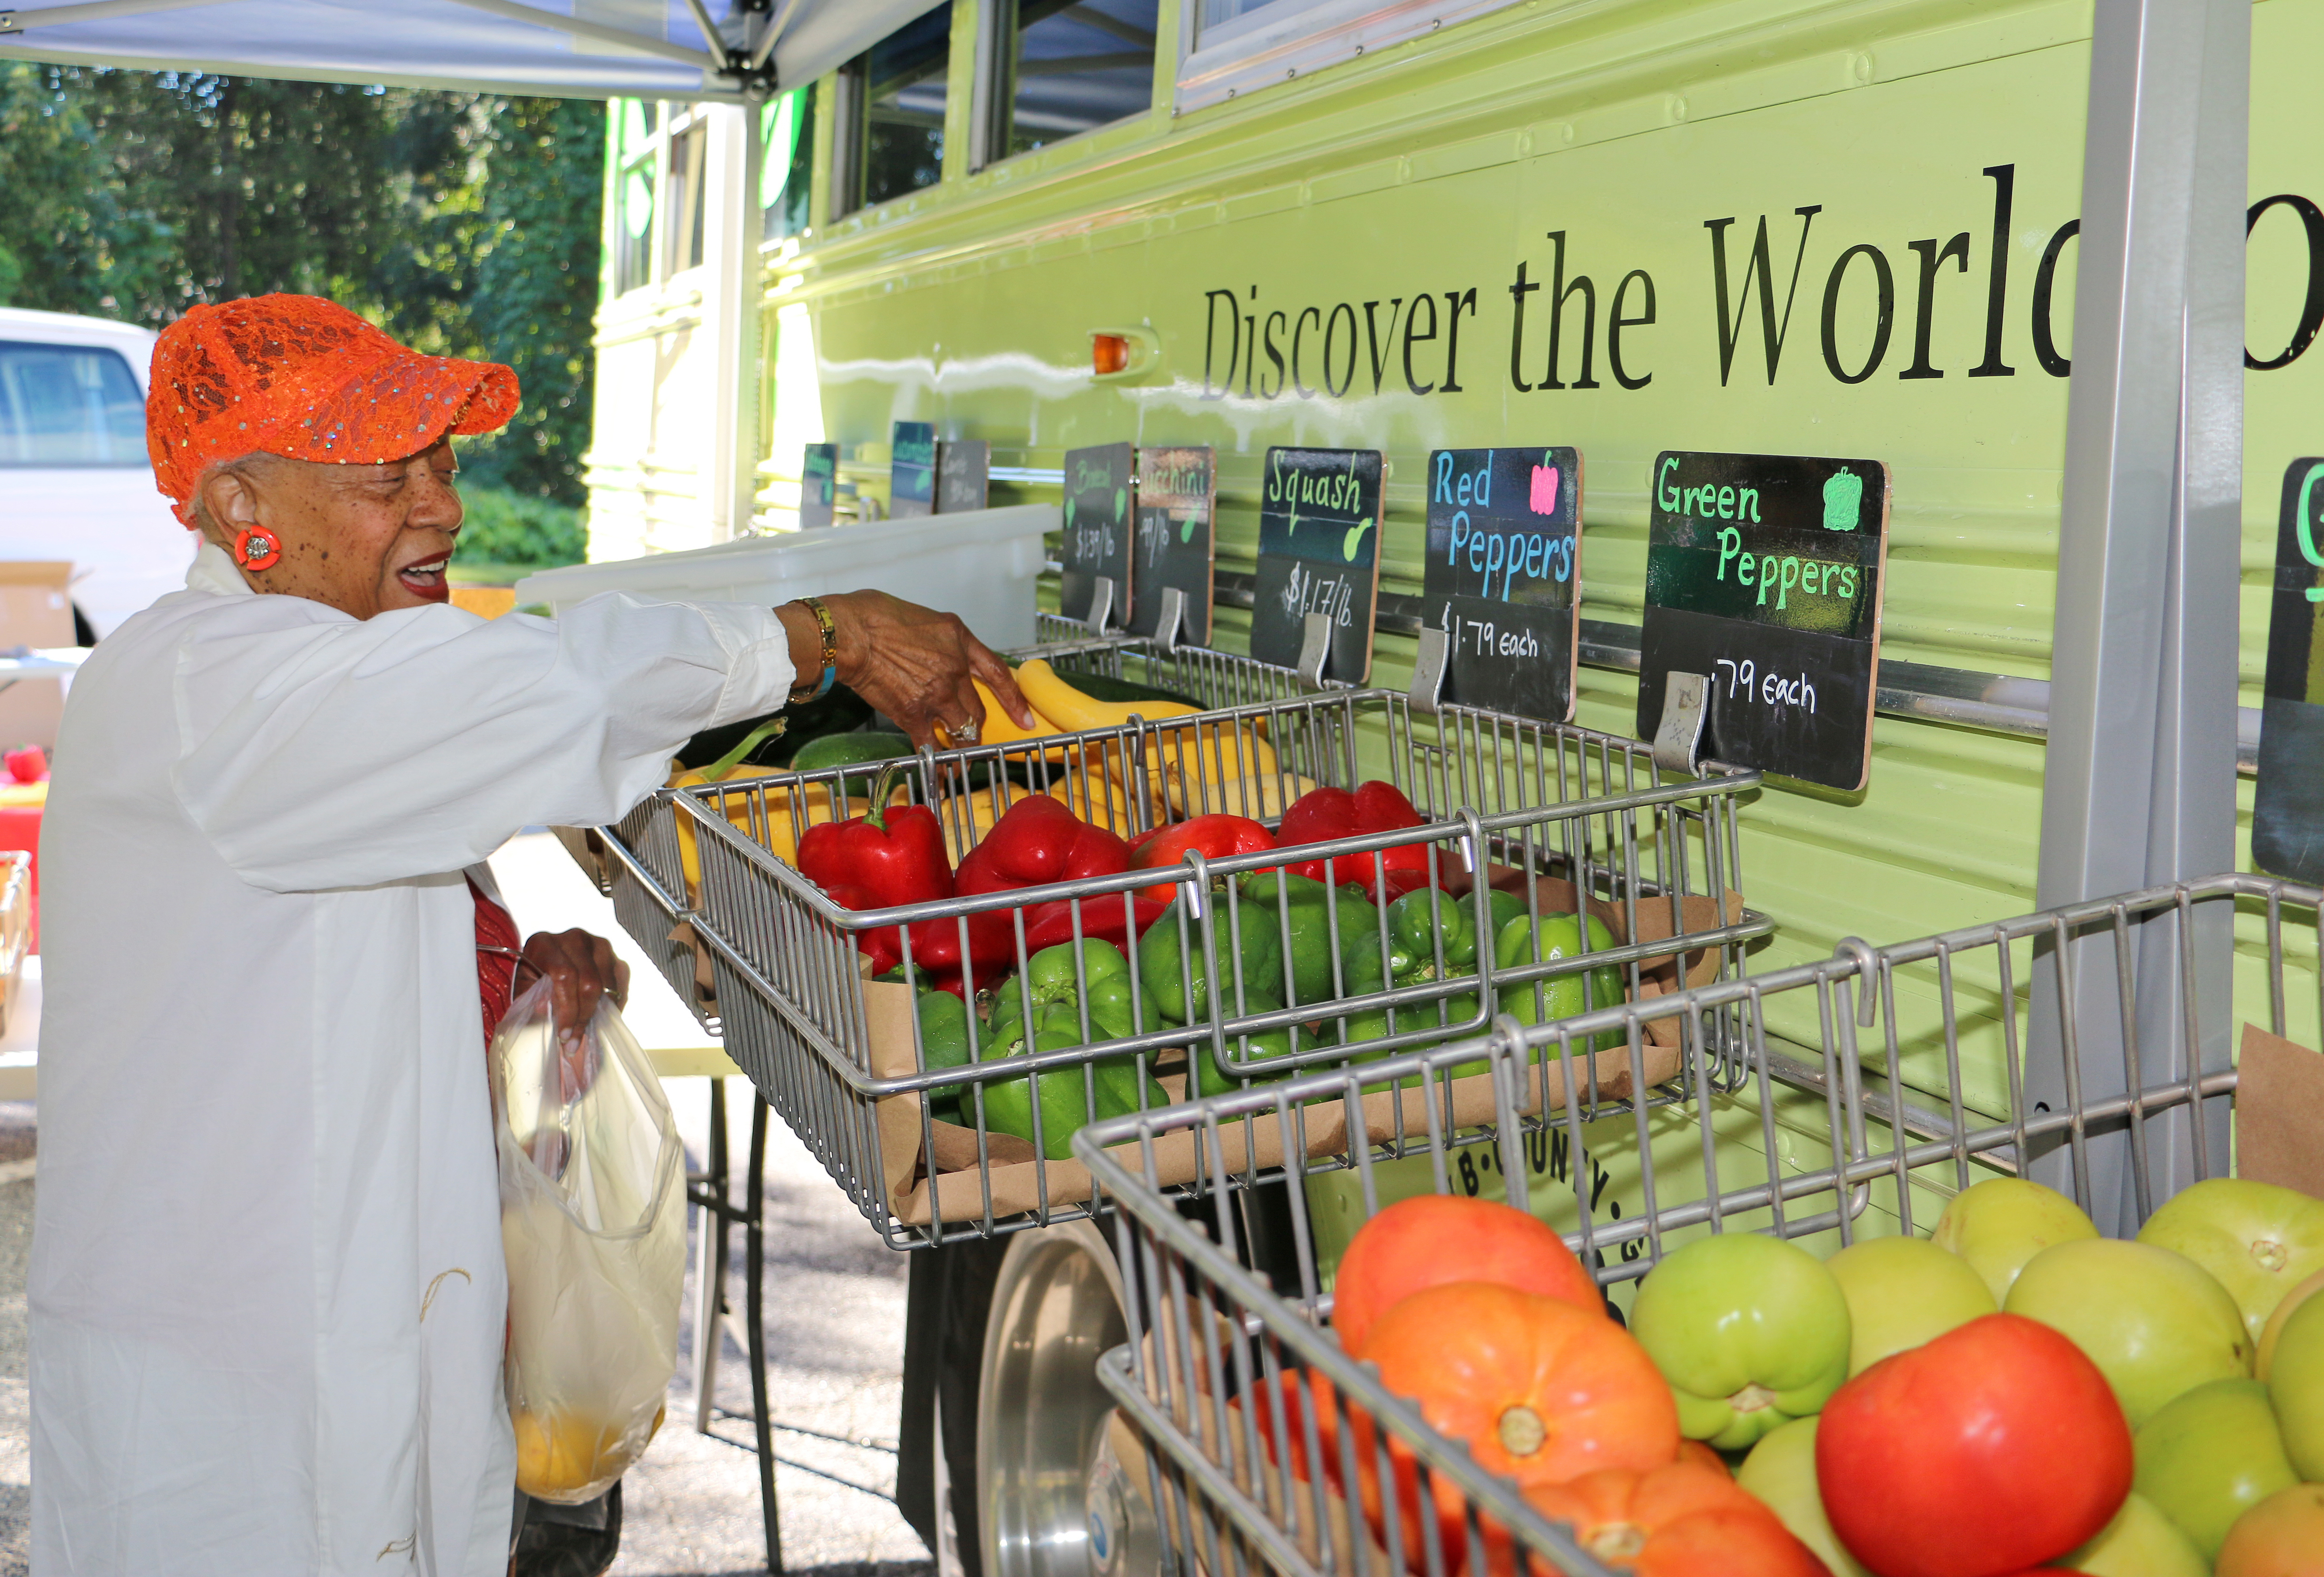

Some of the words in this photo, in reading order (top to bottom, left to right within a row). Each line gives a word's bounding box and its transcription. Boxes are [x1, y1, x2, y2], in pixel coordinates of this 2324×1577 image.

[1199, 285, 1477, 402] Discover
[1509, 230, 1656, 393] the
[1269, 450, 1361, 536] Squash
[1435, 449, 1493, 508] Red
[1657, 458, 1761, 523] Green
[1449, 511, 1577, 602] Peppers
[1716, 526, 1858, 610] Peppers
